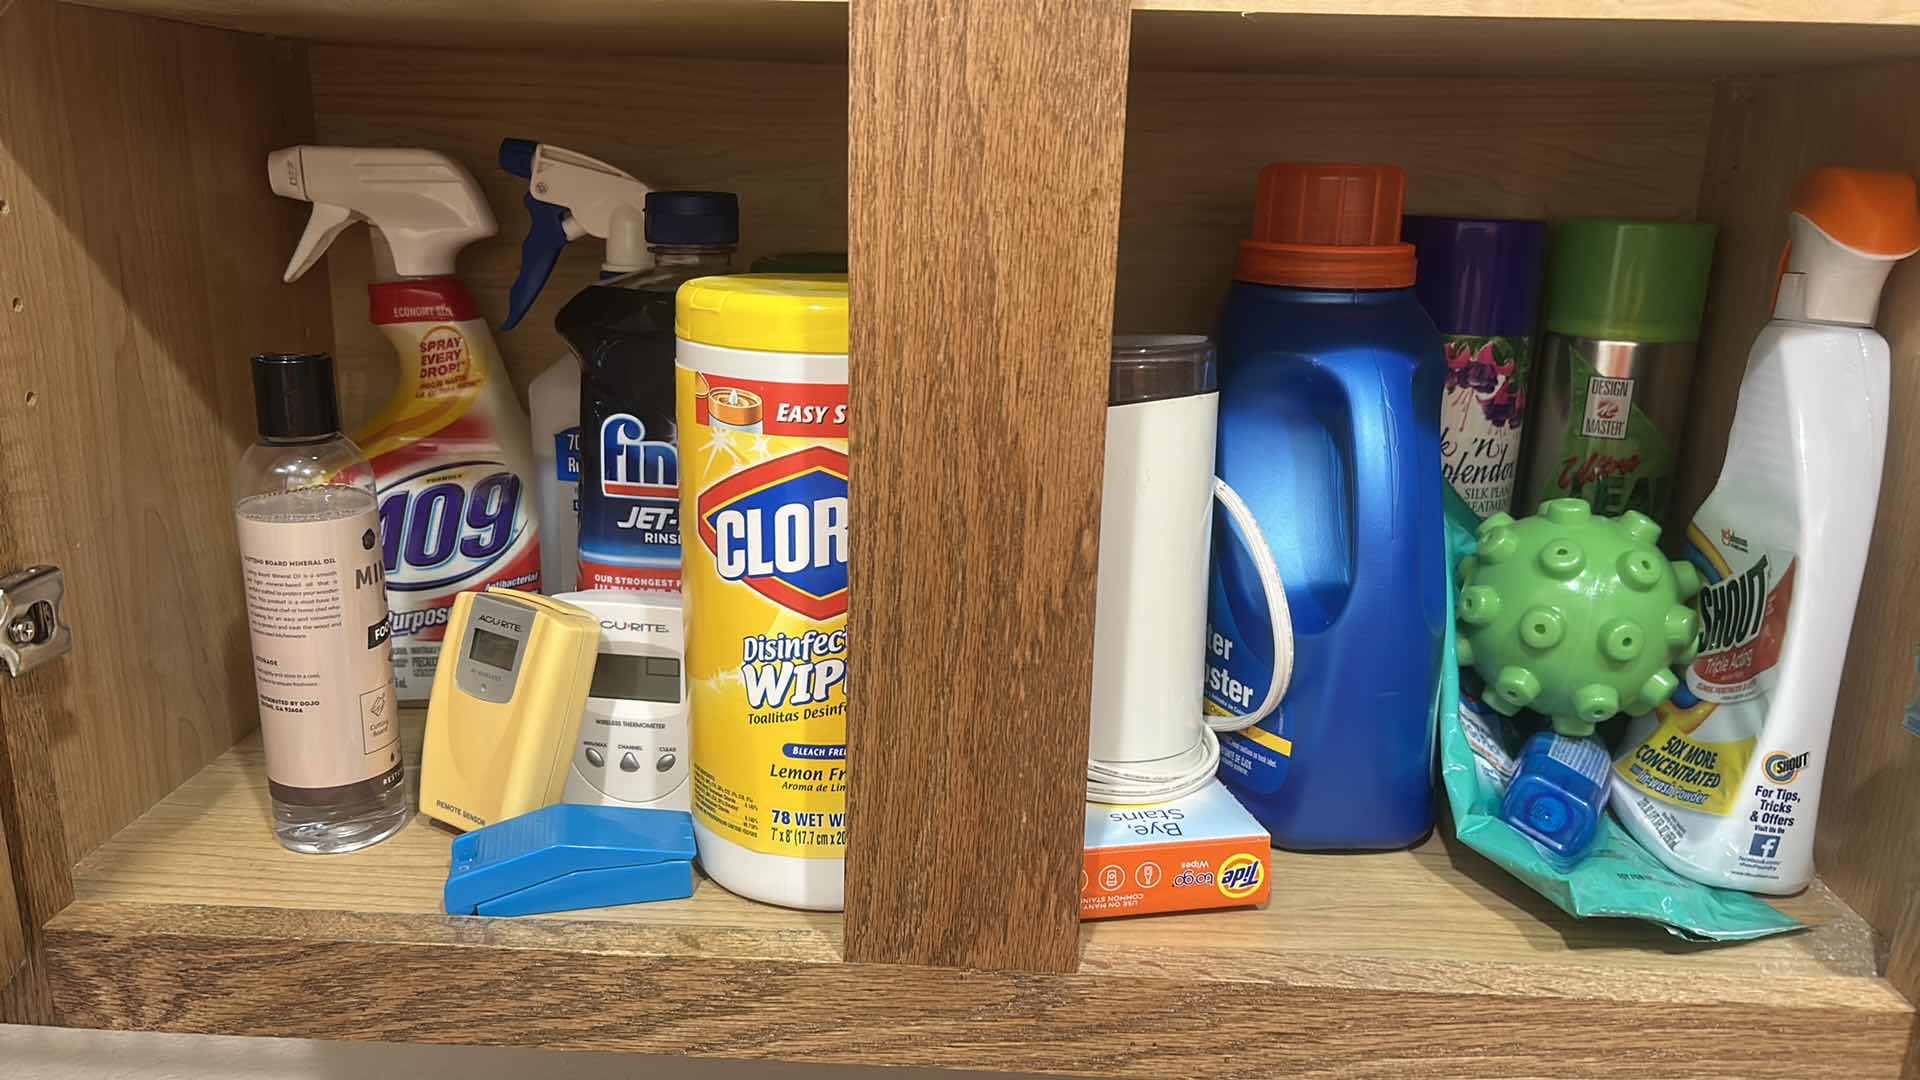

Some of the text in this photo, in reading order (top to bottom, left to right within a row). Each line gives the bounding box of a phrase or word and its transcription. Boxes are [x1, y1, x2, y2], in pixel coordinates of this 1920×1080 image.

[420, 336, 462, 353] SPRAY
[420, 350, 462, 366] EVERY
[1591, 379, 1629, 398] DESIGN
[776, 402, 829, 425] EASY
[1585, 418, 1625, 436] MASTER
[1464, 487, 1490, 500] SILK
[379, 472, 521, 572] 109
[716, 497, 848, 579] CLOR
[289, 559, 322, 567] MINERAL
[323, 557, 337, 565] OIL
[485, 570, 539, 592] Antibacterial
[594, 573, 673, 588] OUR STRONGEST
[1698, 553, 1769, 653] SHOUT
[741, 658, 848, 709] WIP
[596, 719, 666, 730] WIRELESS THERMOMETER
[747, 711, 799, 726] Toallitas
[618, 743, 643, 752] CHANNEL
[792, 745, 826, 758] BLEACH
[1684, 743, 1719, 770] MORE
[1776, 751, 1810, 774] SHOUT
[770, 763, 823, 782] Lemon
[1635, 744, 1722, 789] CONCENTRATED
[781, 781, 814, 793] Aroma
[815, 781, 828, 793] de
[1755, 785, 1801, 803] For Tips,
[436, 799, 486, 826] REMOTE SENSOR
[1110, 808, 1185, 822] Stains
[1760, 799, 1792, 814] Tricks
[772, 809, 791, 825] 78
[795, 812, 825, 828] WET
[1749, 810, 1795, 827] & Offers
[1127, 821, 1184, 837] Bye,
[1754, 824, 1769, 833] Visit
[816, 832, 830, 845] cm
[1181, 859, 1210, 869] Wipes
[1174, 869, 1215, 887] to go
[1221, 859, 1260, 889] Tide
[1083, 900, 1139, 911] USE ON MANY
[1108, 893, 1144, 902] COMMON
